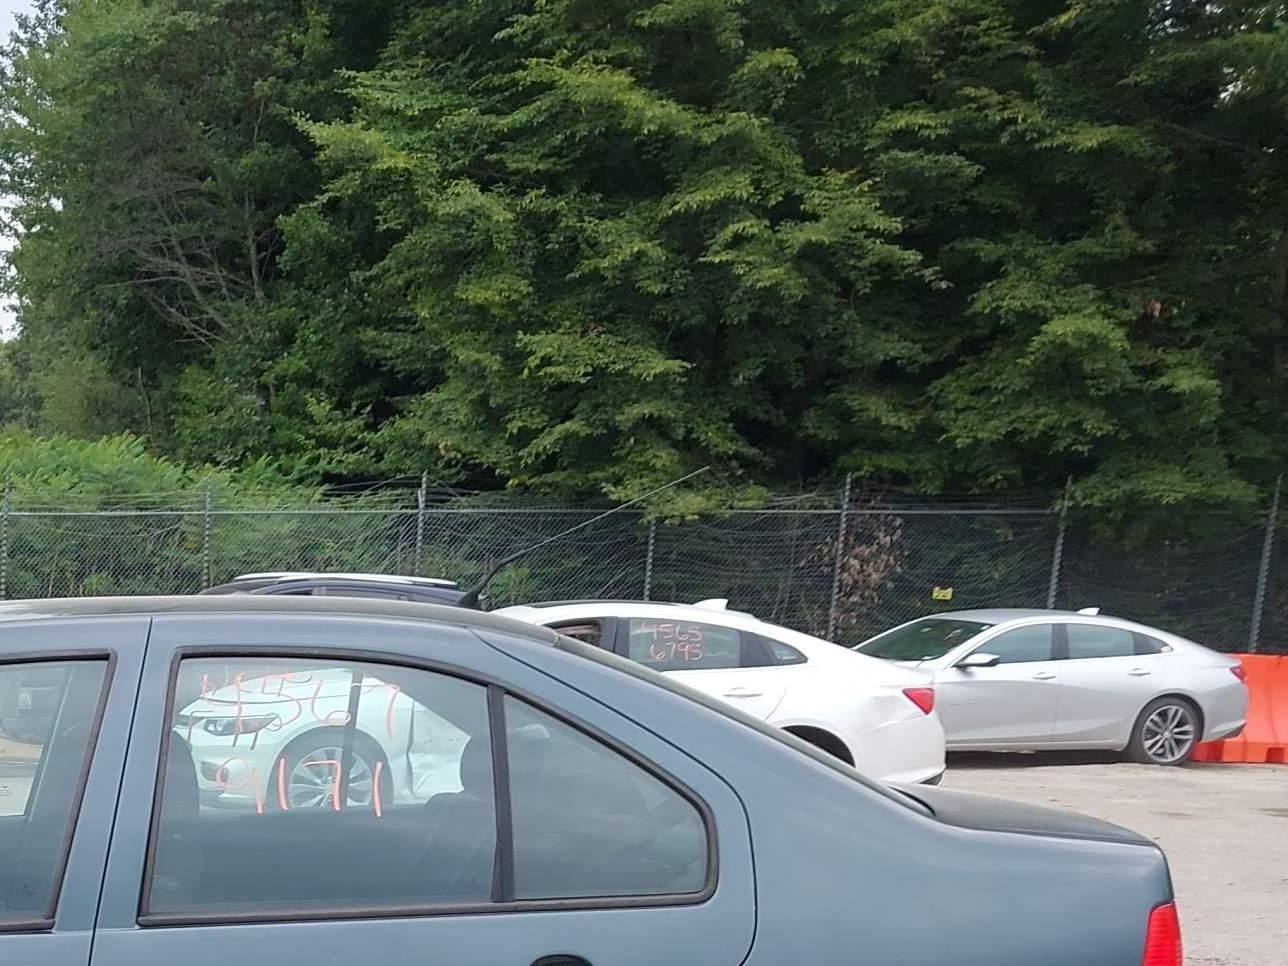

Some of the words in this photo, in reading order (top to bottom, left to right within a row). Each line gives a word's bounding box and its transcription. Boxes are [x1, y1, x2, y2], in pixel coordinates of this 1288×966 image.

[641, 620, 704, 642] 4565
[650, 642, 704, 662] 6795
[215, 756, 383, 818] 9171
